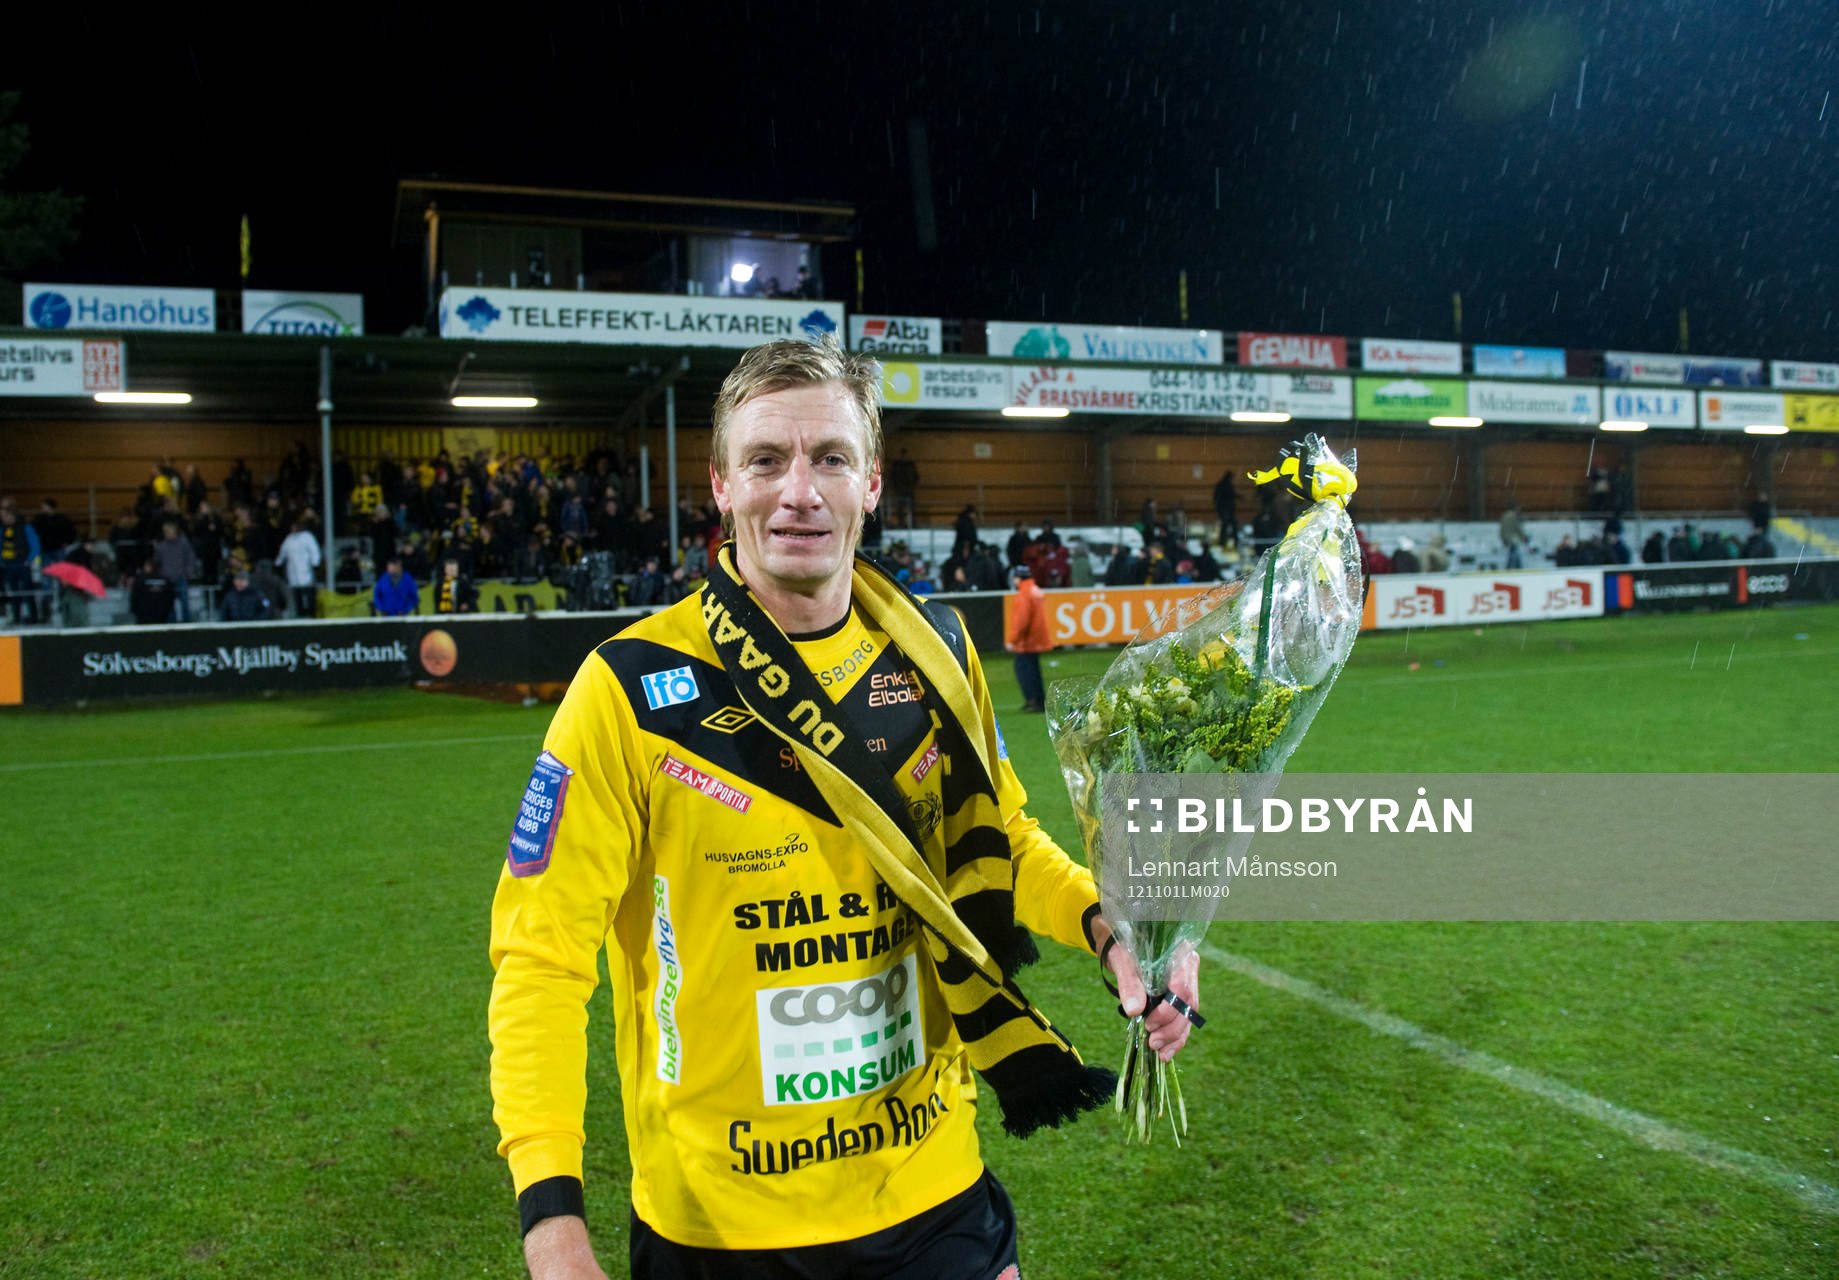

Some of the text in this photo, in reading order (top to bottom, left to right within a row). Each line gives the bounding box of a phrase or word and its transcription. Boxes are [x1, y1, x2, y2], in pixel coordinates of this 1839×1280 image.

[77, 296, 210, 326] Hanöhus
[508, 306, 792, 335] TELEFFEKT-LÄKTAREN
[886, 320, 929, 340] Abu
[1250, 336, 1337, 368] GEVALIA
[924, 369, 1002, 384] arbetslivs
[924, 385, 978, 398] resurs
[83, 640, 408, 676] Sölvesborg-Mjällby Sparbank
[787, 700, 845, 757] DU
[663, 757, 750, 812] TEAM SPORTIA
[705, 842, 809, 863] HUSVAGNS-EXPO
[728, 859, 786, 874] BROMÖLLA
[733, 891, 829, 930] STÅL
[839, 892, 869, 918] &
[653, 878, 679, 1081] blekingeflyg.se
[770, 963, 909, 1026] coop
[776, 1039, 916, 1102] KONSUM
[729, 1117, 884, 1176] Sweden
